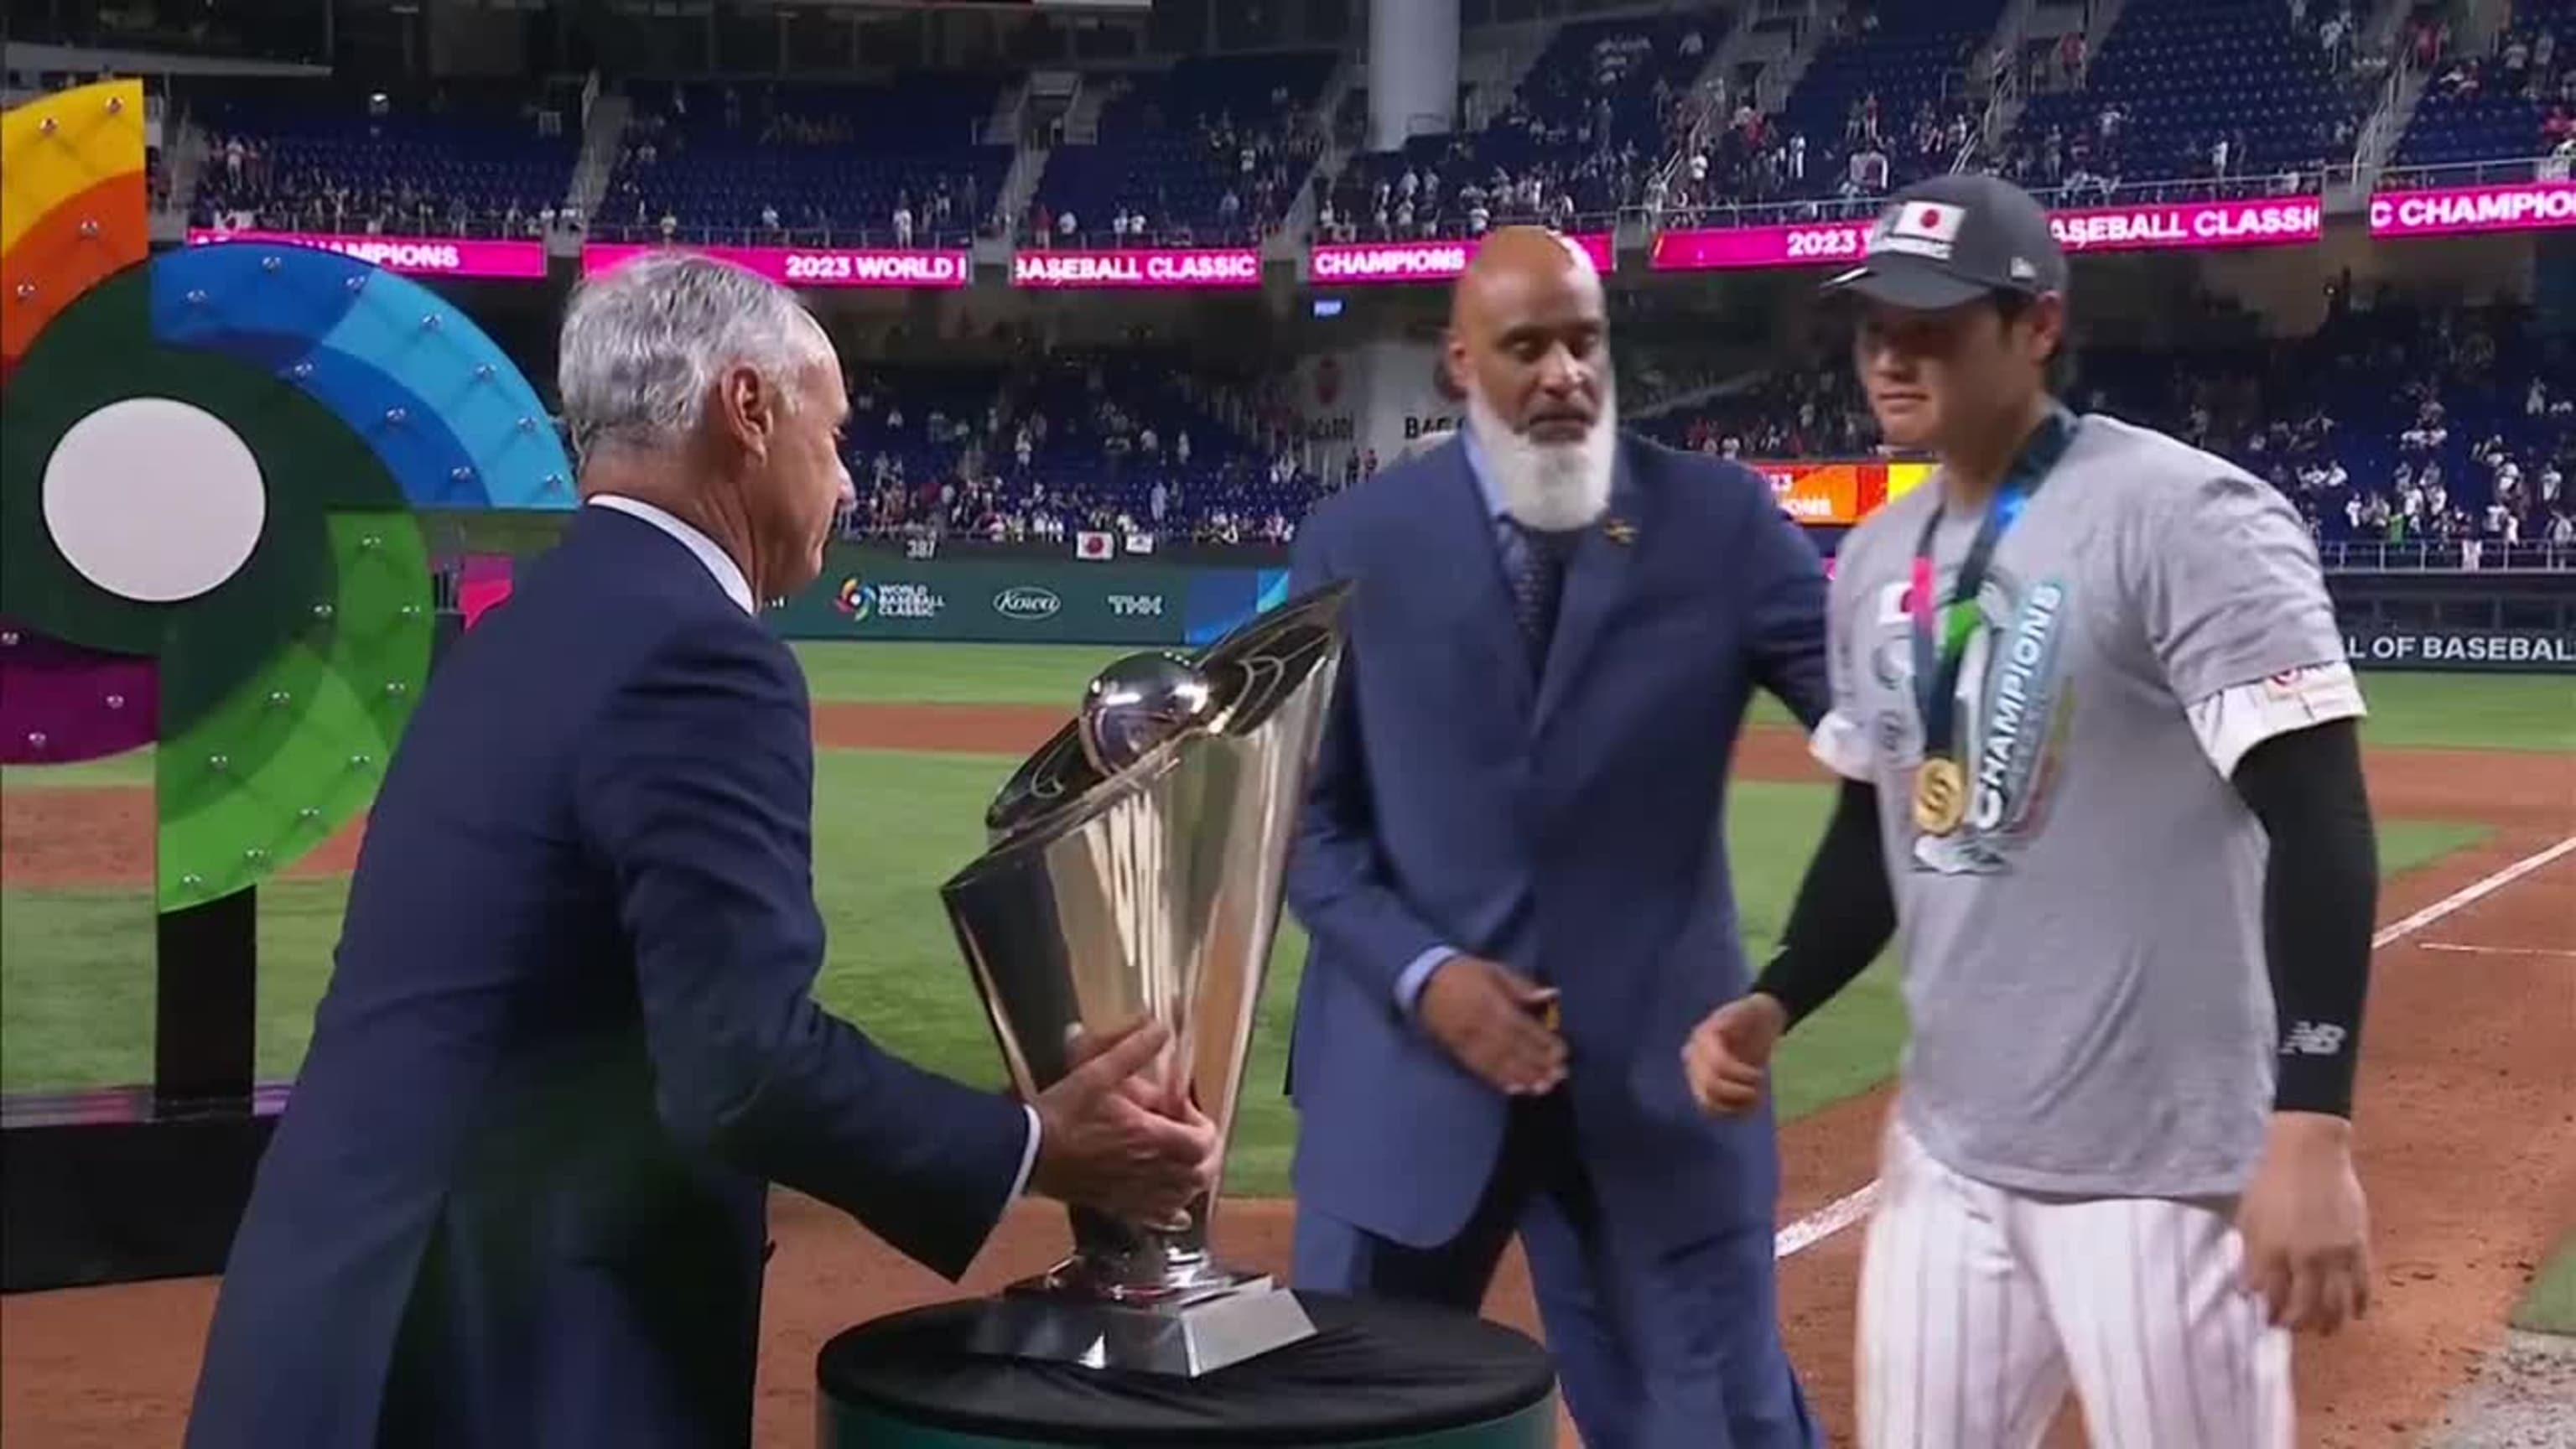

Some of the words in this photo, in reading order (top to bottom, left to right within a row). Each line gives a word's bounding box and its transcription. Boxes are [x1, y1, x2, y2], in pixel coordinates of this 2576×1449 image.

[2399, 191, 2576, 226] CHAMPIO
[2050, 212, 2188, 243] ASEBALL
[1787, 229, 1856, 257] 2023
[785, 255, 850, 278] 2023
[855, 257, 953, 278] WORLD
[1147, 255, 1256, 278] CLASSIC
[1315, 248, 1465, 274] CHAMPIONS
[878, 584, 927, 595] WORLD
[879, 595, 945, 606] BASEBALL
[998, 590, 1055, 611] Kowa
[878, 605, 934, 617] CLASSIC
[2372, 636, 2416, 659] OF
[1976, 585, 2061, 829] CHAMPIONS
